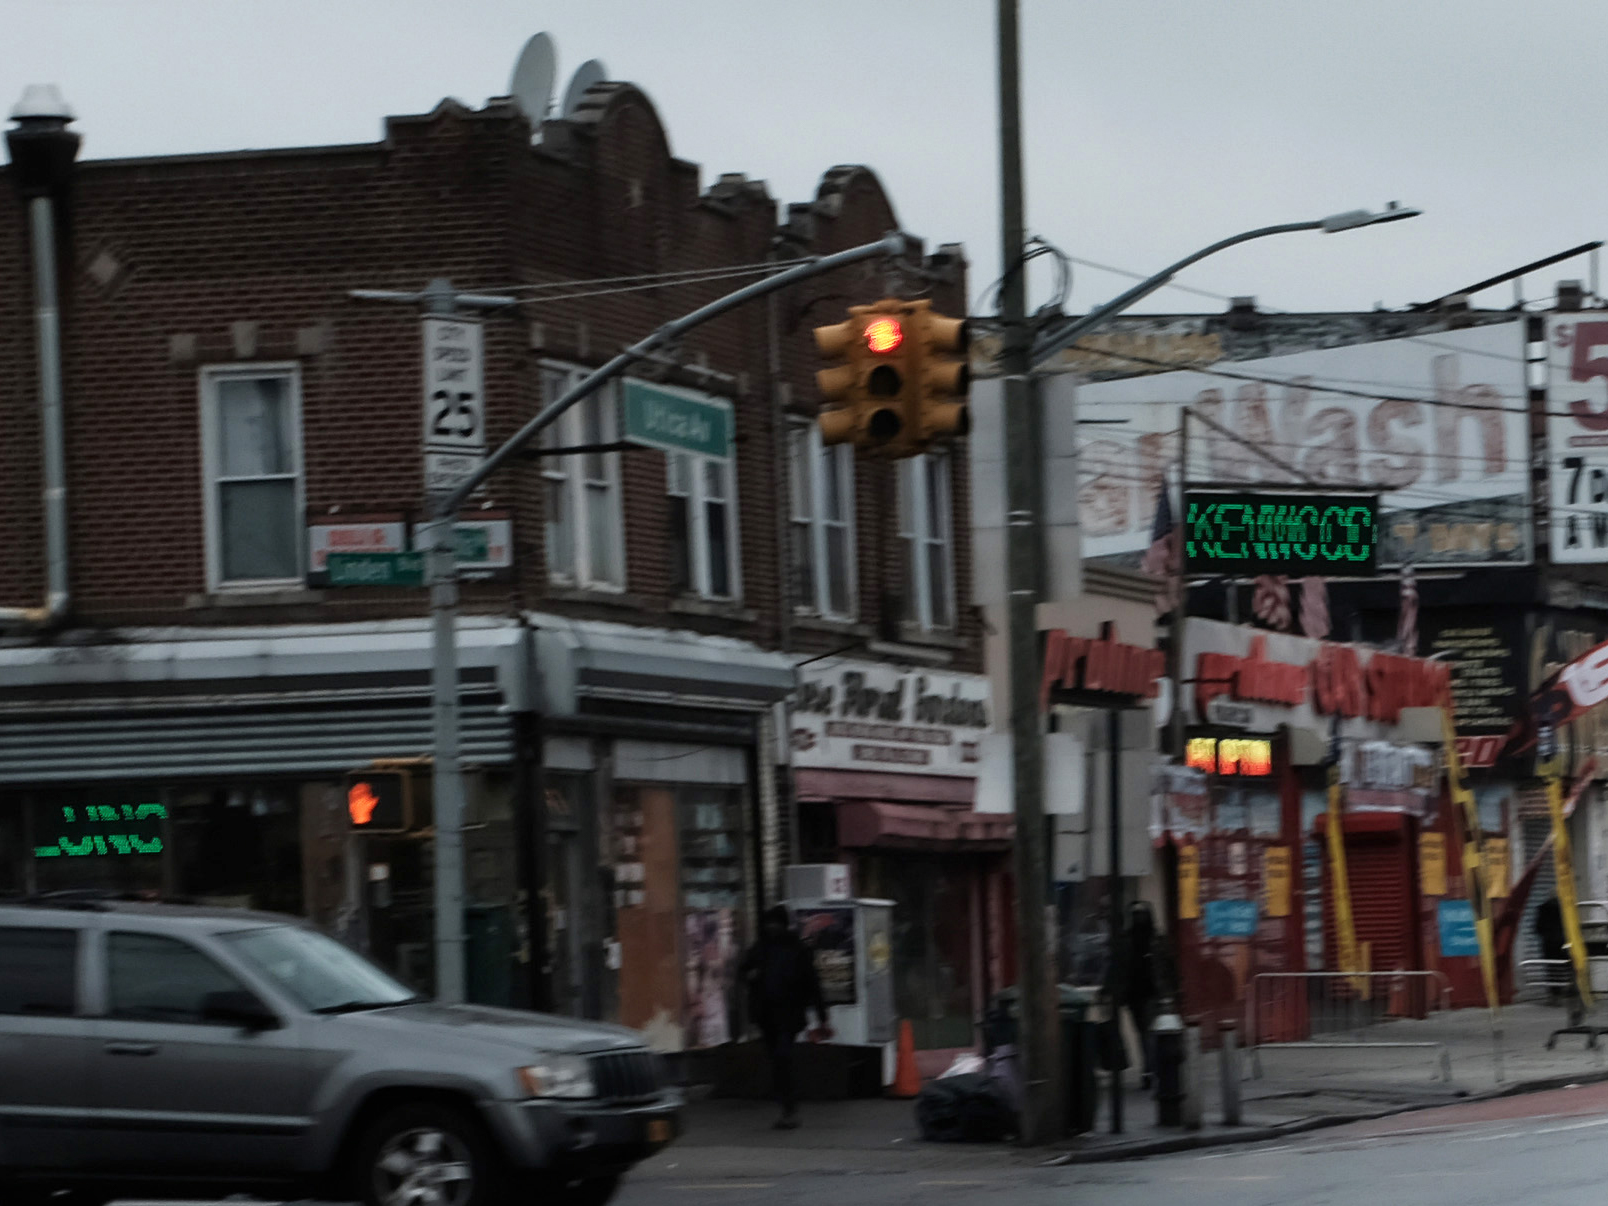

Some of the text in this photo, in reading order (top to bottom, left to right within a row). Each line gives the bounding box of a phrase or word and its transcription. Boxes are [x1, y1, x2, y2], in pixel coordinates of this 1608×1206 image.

[433, 390, 478, 437] 25
[1563, 456, 1584, 504] 7
[1565, 514, 1581, 549] A
